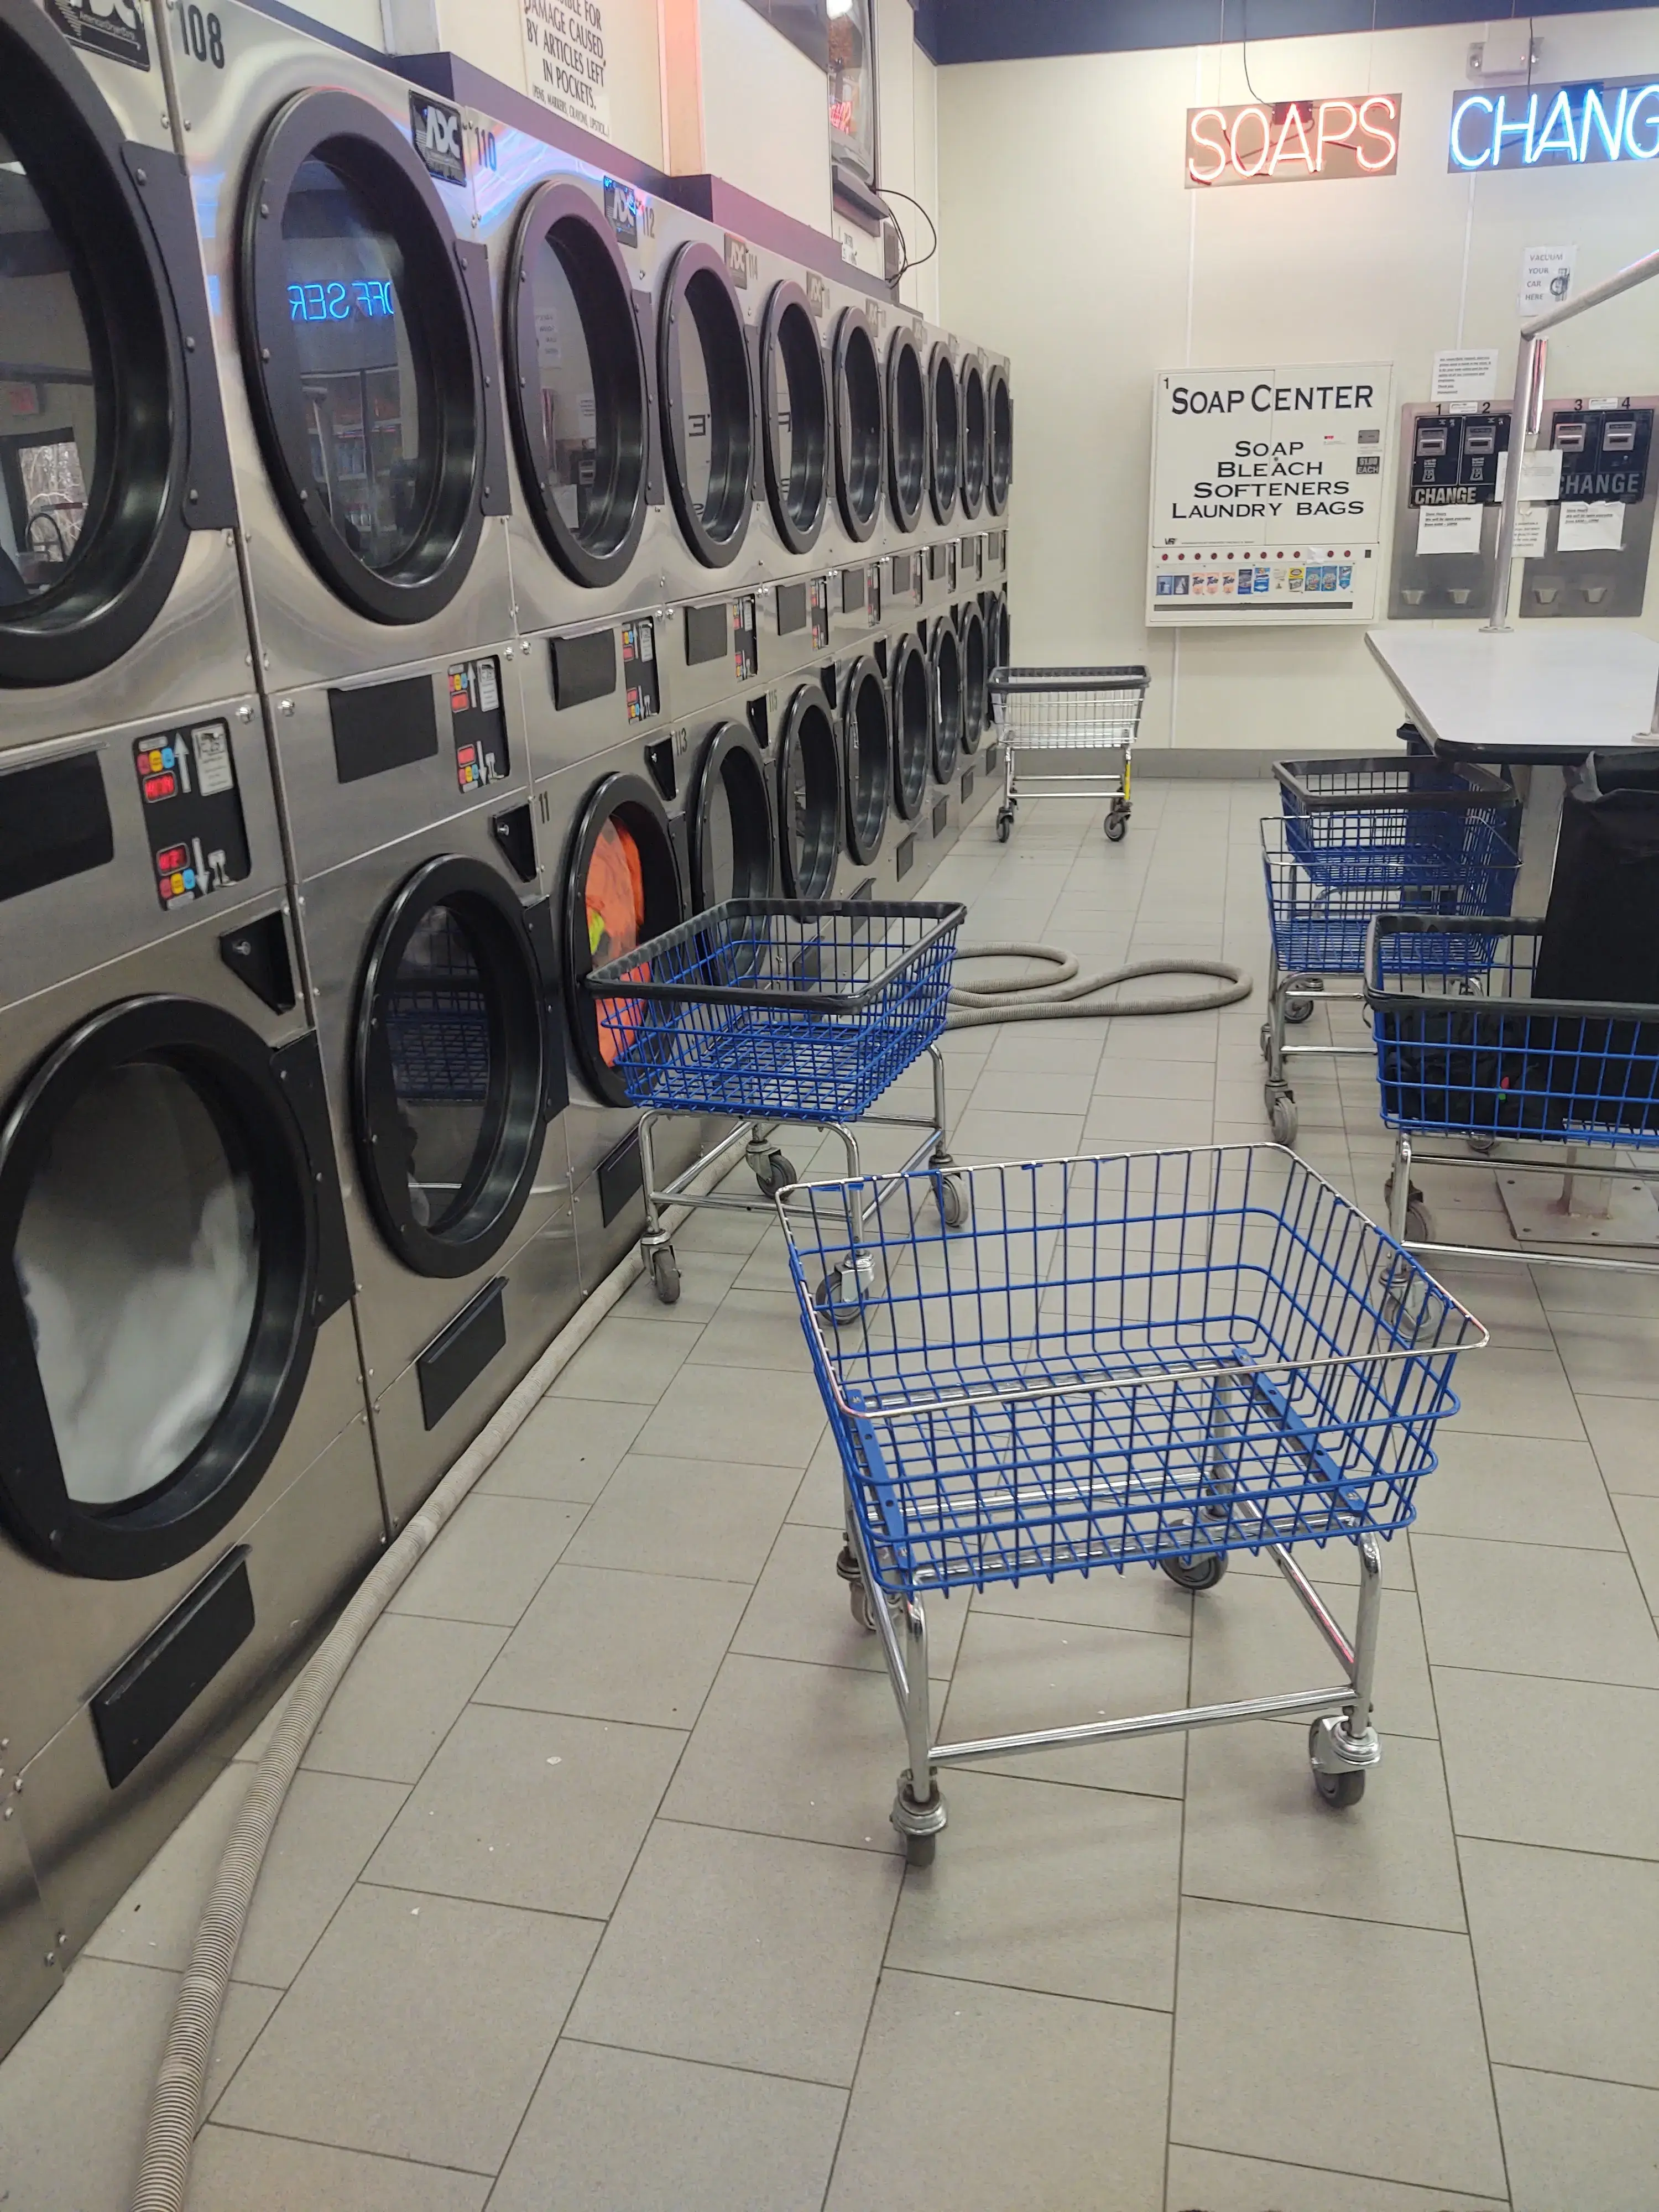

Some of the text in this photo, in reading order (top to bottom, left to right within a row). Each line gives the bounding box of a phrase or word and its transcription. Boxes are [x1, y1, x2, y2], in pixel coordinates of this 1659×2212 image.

[585, 0, 602, 32] FOR
[179, 2, 225, 69] 108
[569, 18, 603, 59] CAUSED
[526, 18, 604, 87] BY ARTICLES LEFT
[542, 58, 596, 111] IN POCKETS.
[1188, 96, 1396, 181] SOAPS
[1451, 84, 1659, 167] CHANG
[475, 127, 497, 173] 110
[642, 205, 655, 239] 112
[1163, 377, 1169, 390] 1
[1172, 384, 1373, 415] SOAP CENTER
[1436, 404, 1441, 415] 1
[1482, 402, 1490, 413] 2
[1574, 399, 1583, 410] 3
[1621, 397, 1630, 409] 4
[1235, 441, 1304, 457] SOAP
[1217, 461, 1323, 478] BLEACH
[1357, 466, 1378, 474] EACH
[1194, 481, 1349, 498] SOFTENERS
[1414, 486, 1477, 504] CHANGE
[1172, 501, 1364, 519] LAUNDRY BAGS
[675, 727, 687, 757] 113
